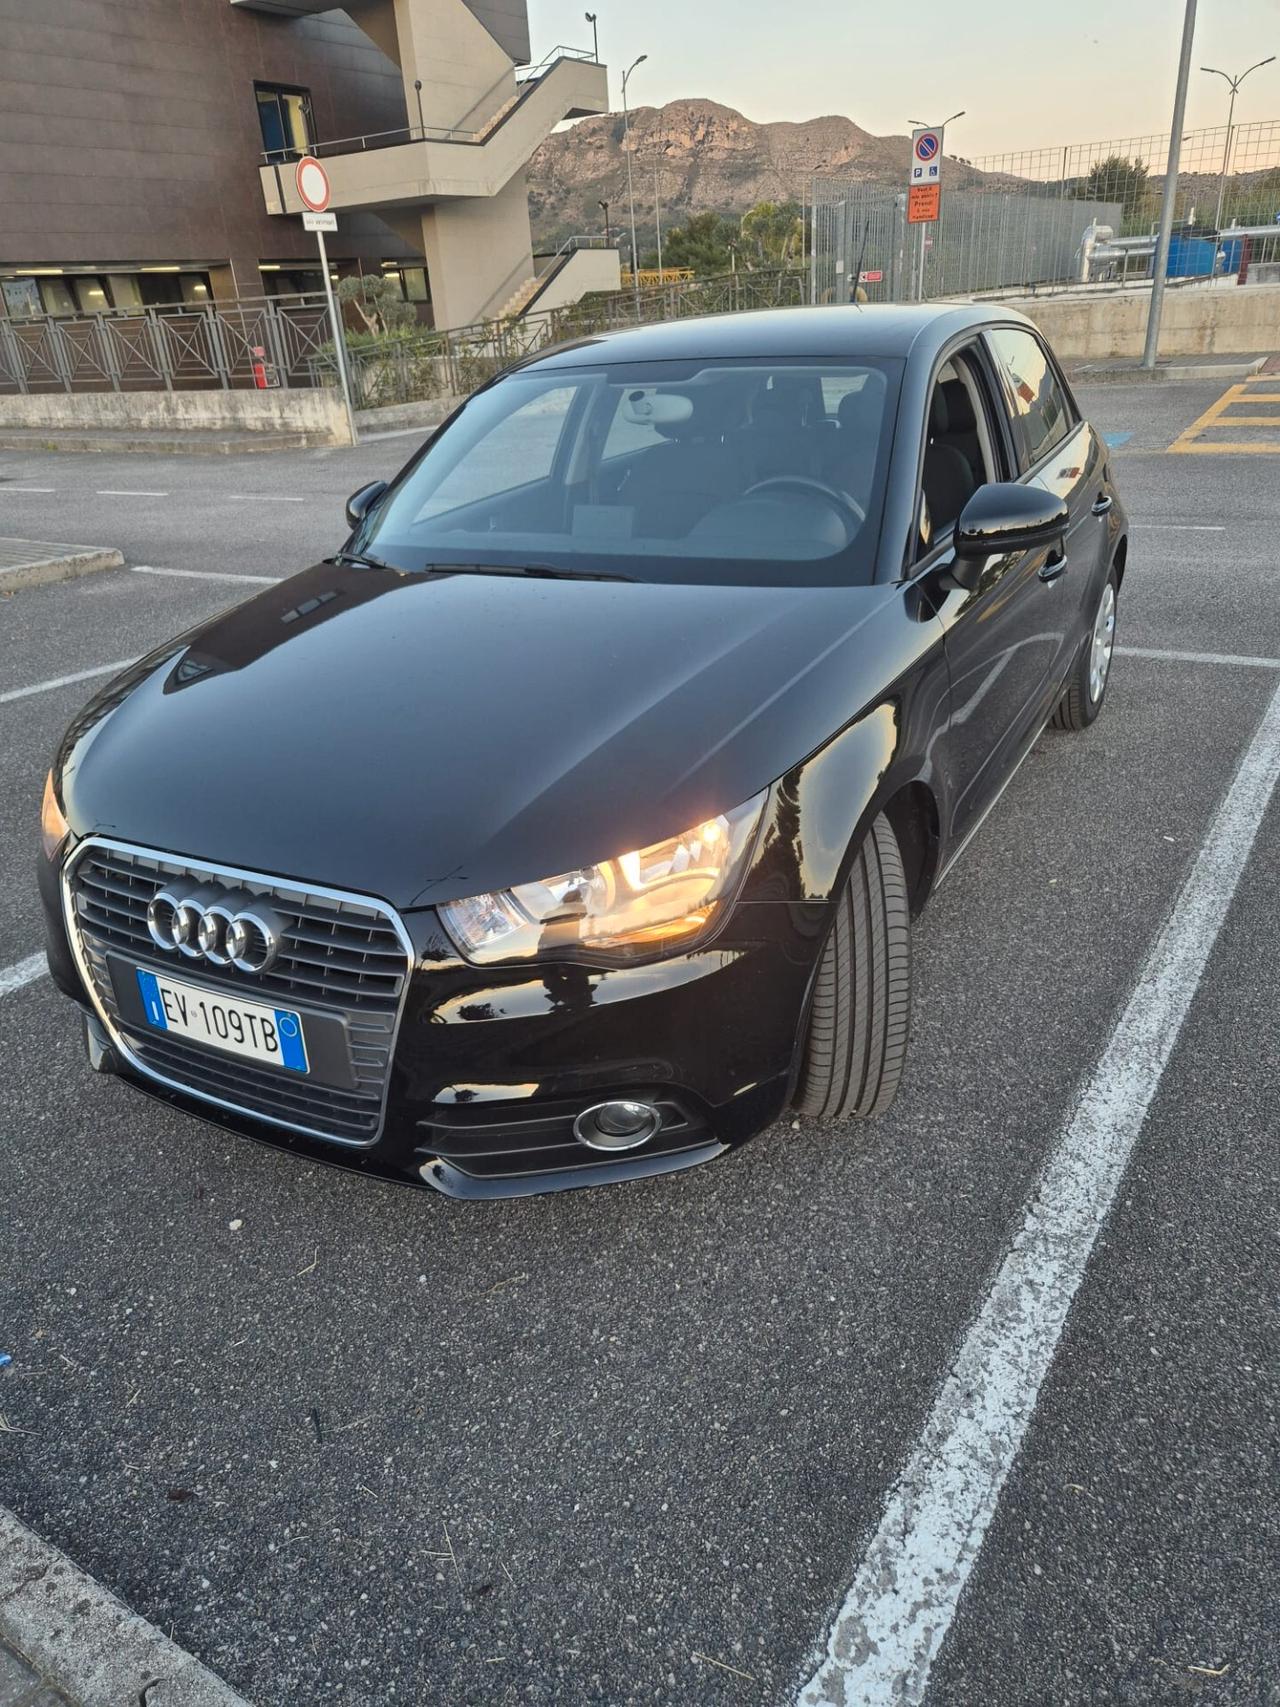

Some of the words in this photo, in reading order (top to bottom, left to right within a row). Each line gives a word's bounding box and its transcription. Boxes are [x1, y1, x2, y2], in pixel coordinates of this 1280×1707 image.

[152, 1001, 159, 1020] I
[160, 988, 188, 1027] EV
[199, 1001, 278, 1052] 109TB
